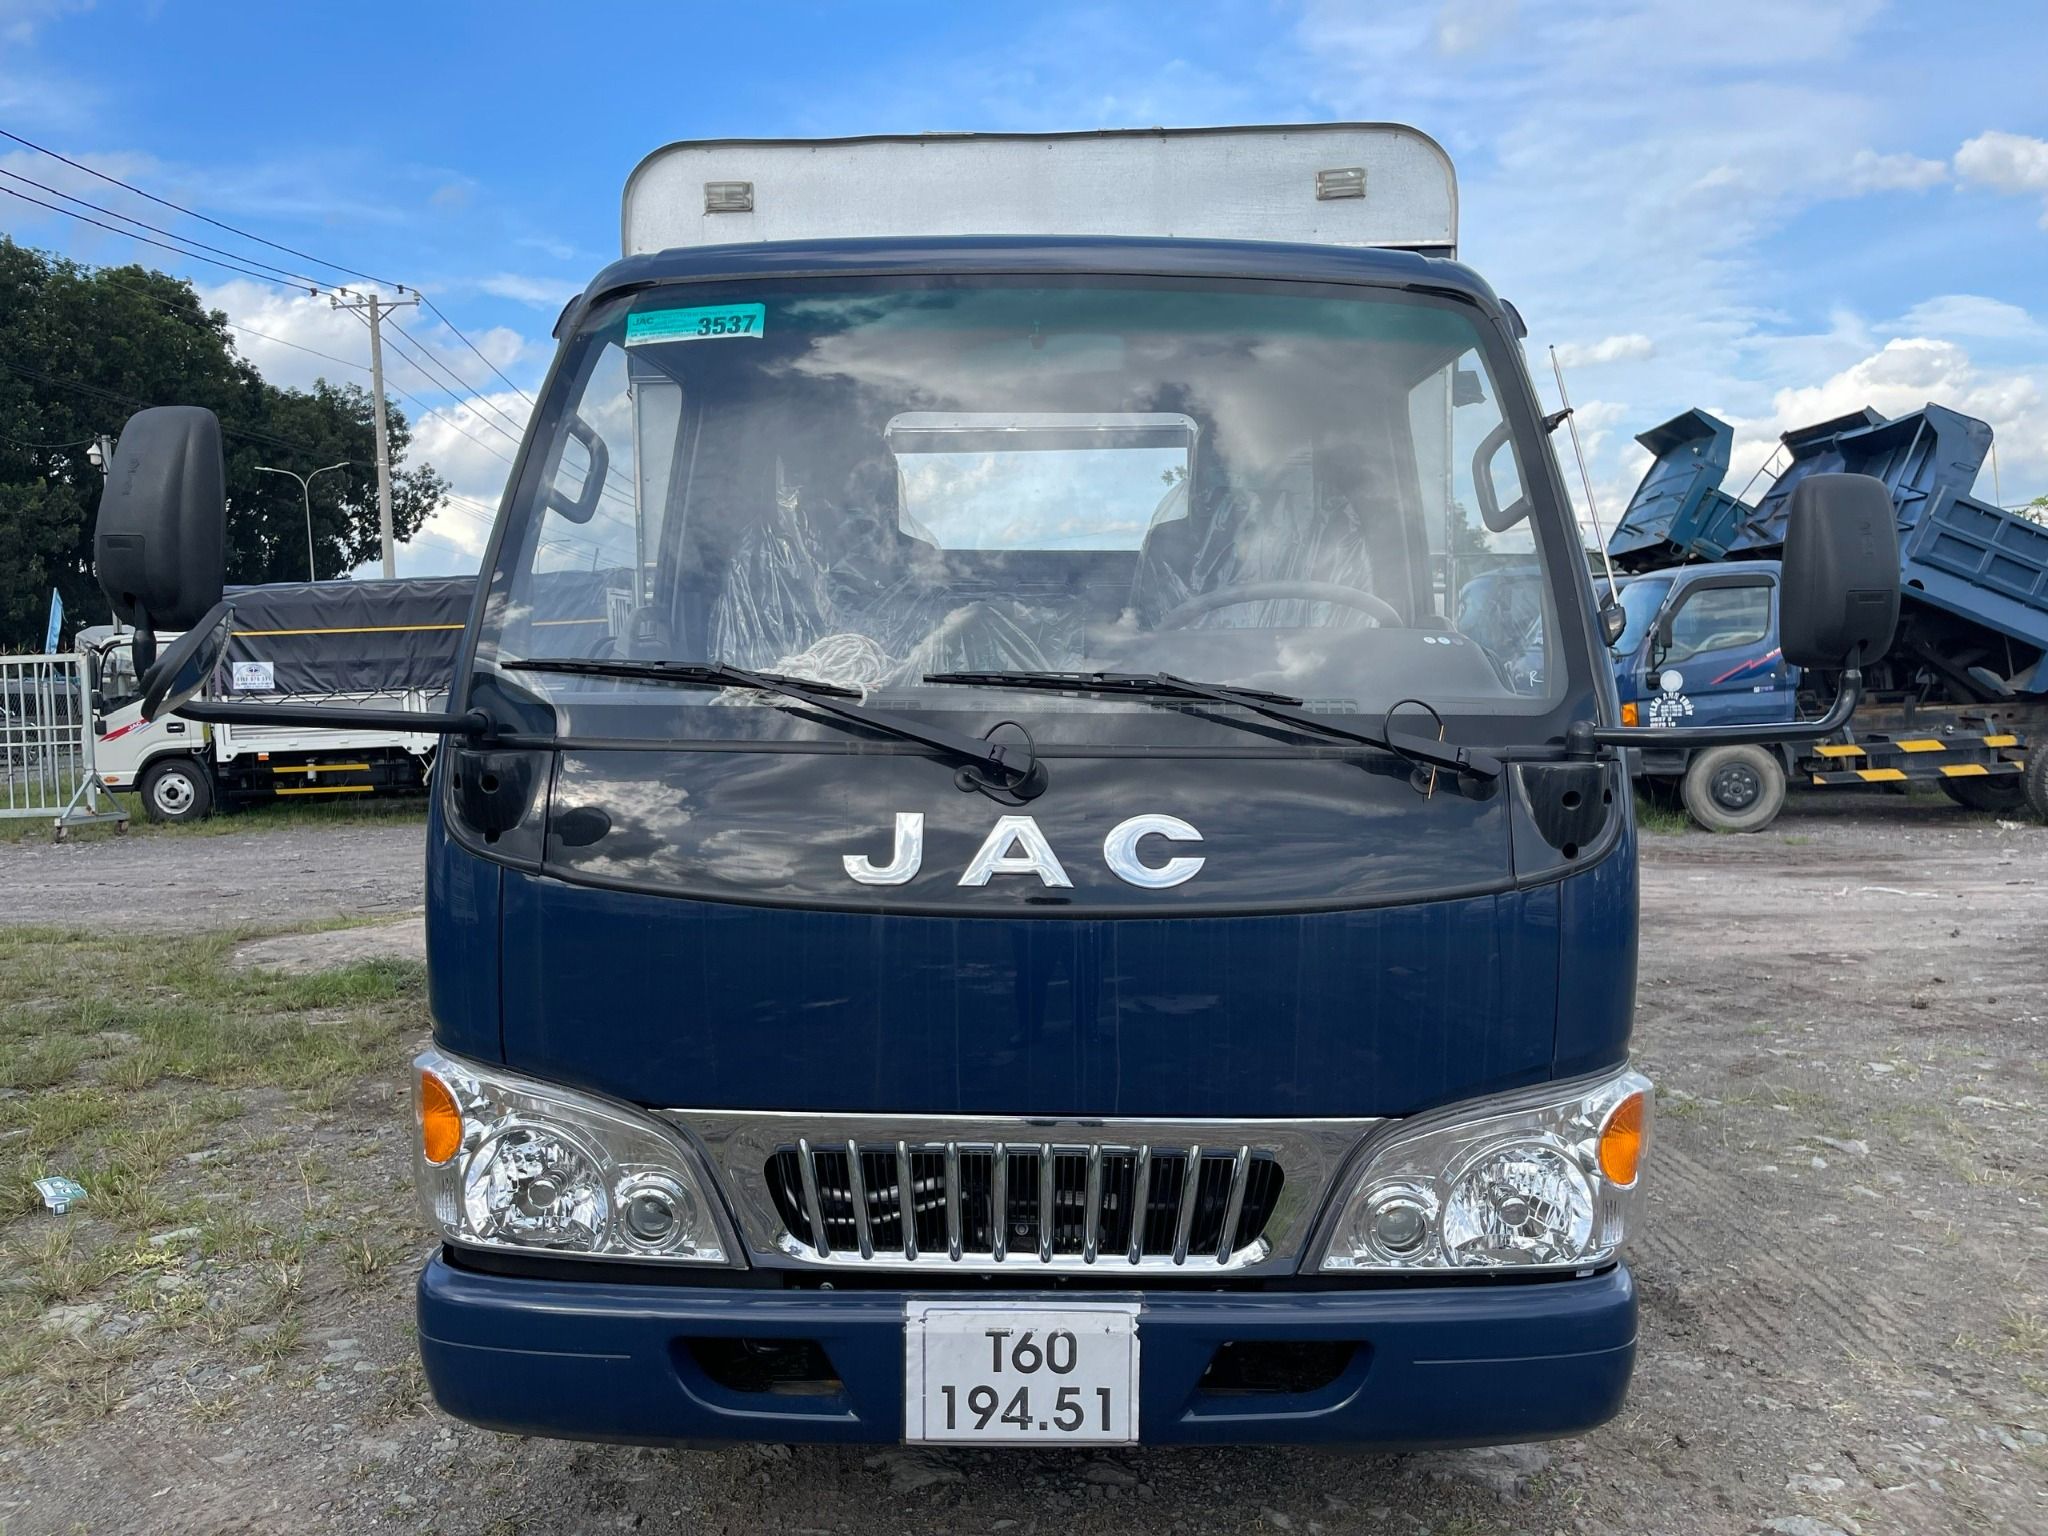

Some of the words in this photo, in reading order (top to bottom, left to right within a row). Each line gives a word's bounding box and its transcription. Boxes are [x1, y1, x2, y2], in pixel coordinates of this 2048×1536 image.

[633, 317, 655, 326] JAC
[697, 314, 757, 336] 3537
[128, 721, 142, 731] JAC
[842, 812, 1206, 889] JAC
[985, 1327, 1078, 1374] T60
[941, 1385, 1111, 1432] 194.51
